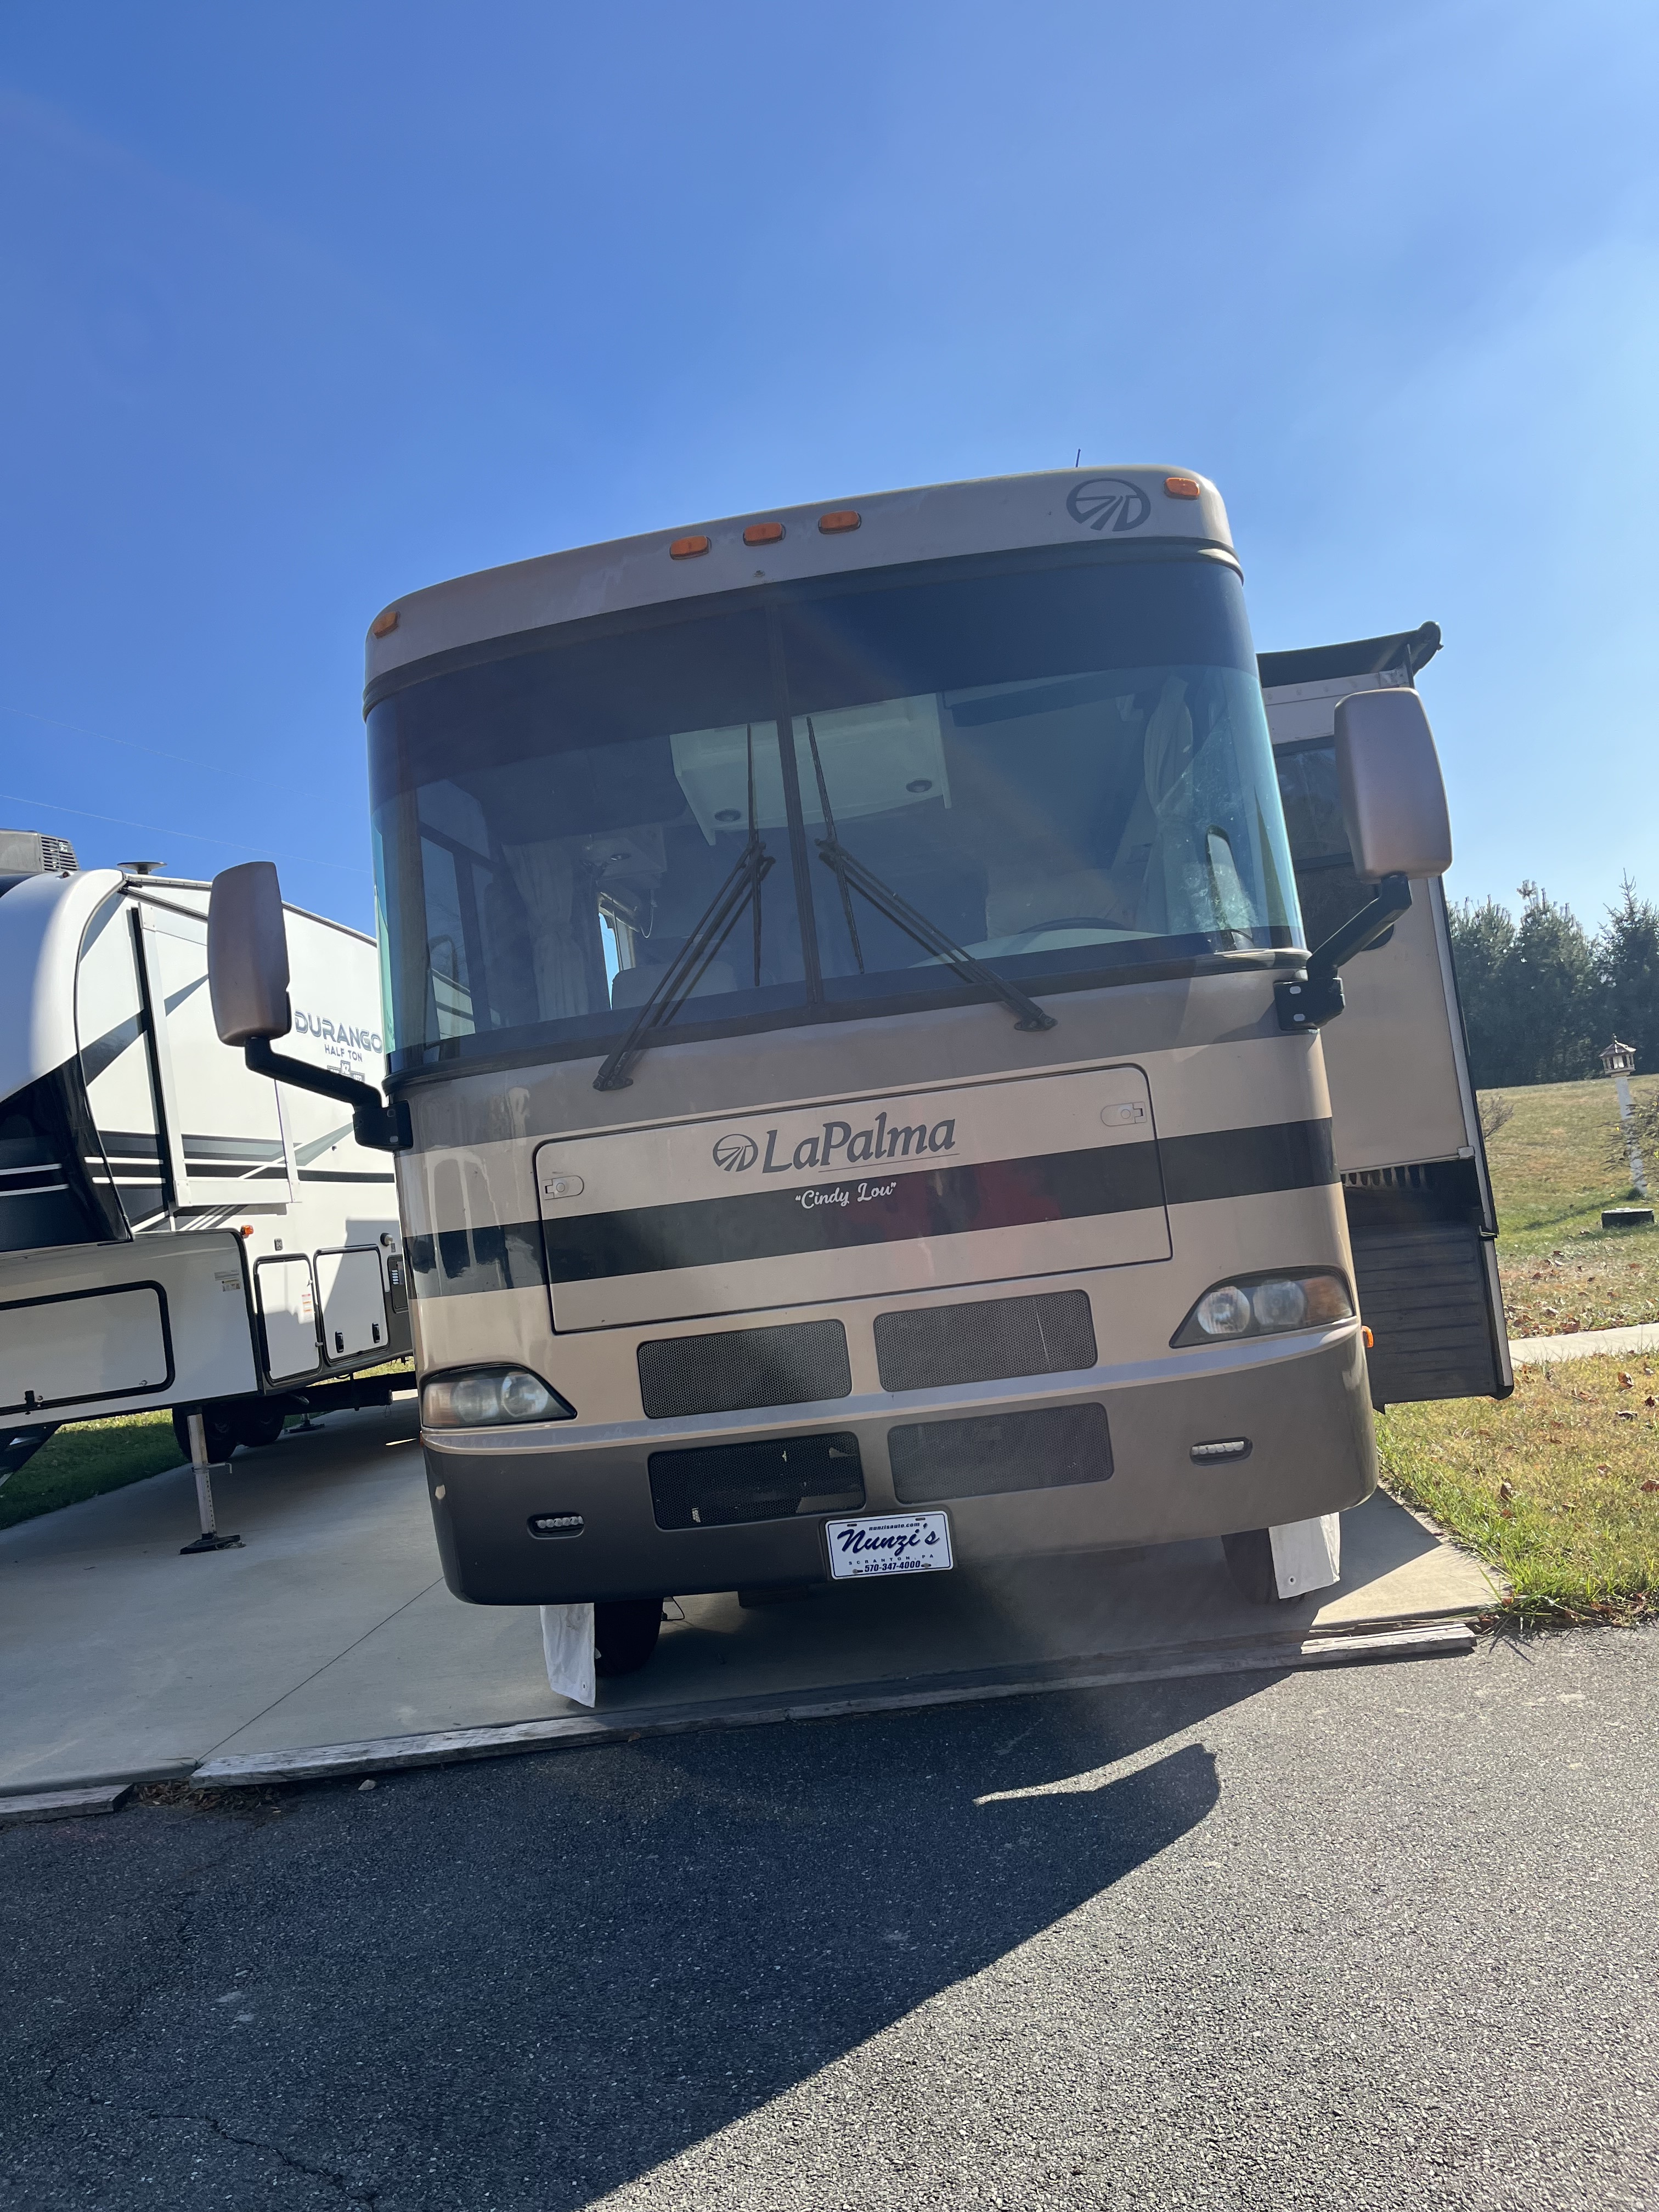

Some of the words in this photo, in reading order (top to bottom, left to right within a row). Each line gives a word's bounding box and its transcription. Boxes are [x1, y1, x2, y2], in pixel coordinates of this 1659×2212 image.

[295, 1009, 383, 1053] DURANGO
[324, 1044, 345, 1057] HALF
[348, 1050, 363, 1062] TON
[761, 1111, 956, 1173] LaPalma
[837, 1522, 940, 1556] Nunzi's
[869, 1522, 921, 1531] nunzisauto.com
[865, 1560, 921, 1572] 570-347-4000
